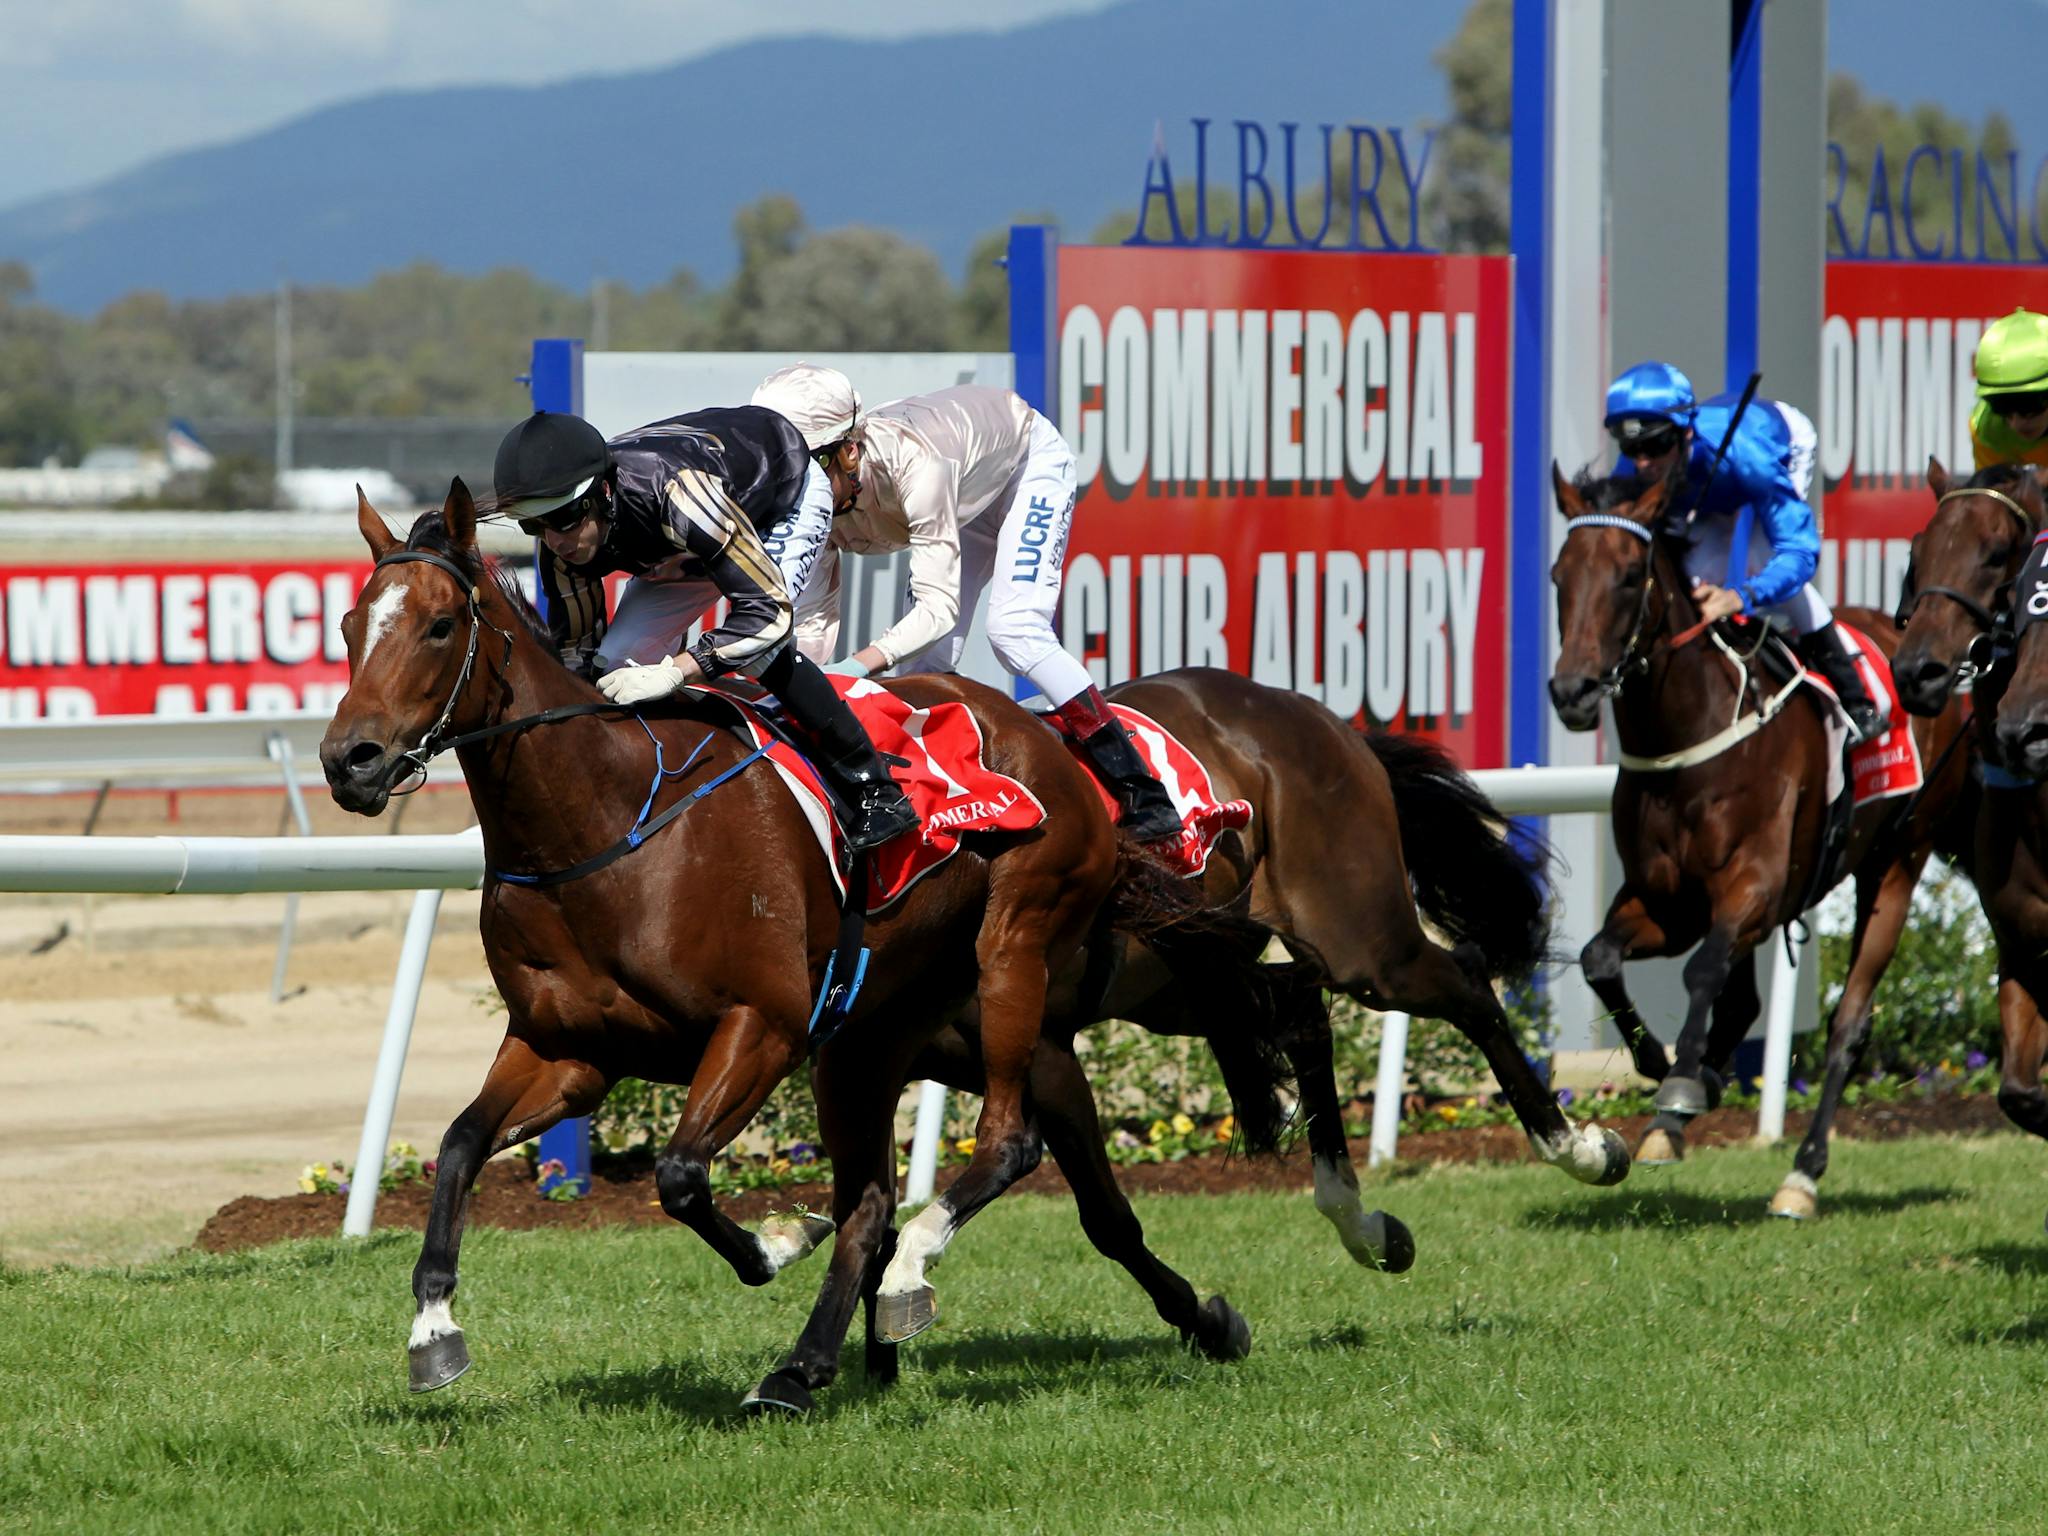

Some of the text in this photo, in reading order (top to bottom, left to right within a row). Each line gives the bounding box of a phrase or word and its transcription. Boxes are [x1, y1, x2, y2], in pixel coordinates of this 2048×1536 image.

[1122, 117, 1439, 252] ALBURY
[1059, 304, 1484, 490] COMMERCIAL
[1820, 315, 1986, 482] OMME
[1011, 494, 1057, 583] LUCRF
[0, 571, 372, 668] MMERCI
[1251, 547, 1485, 721] ALBURY
